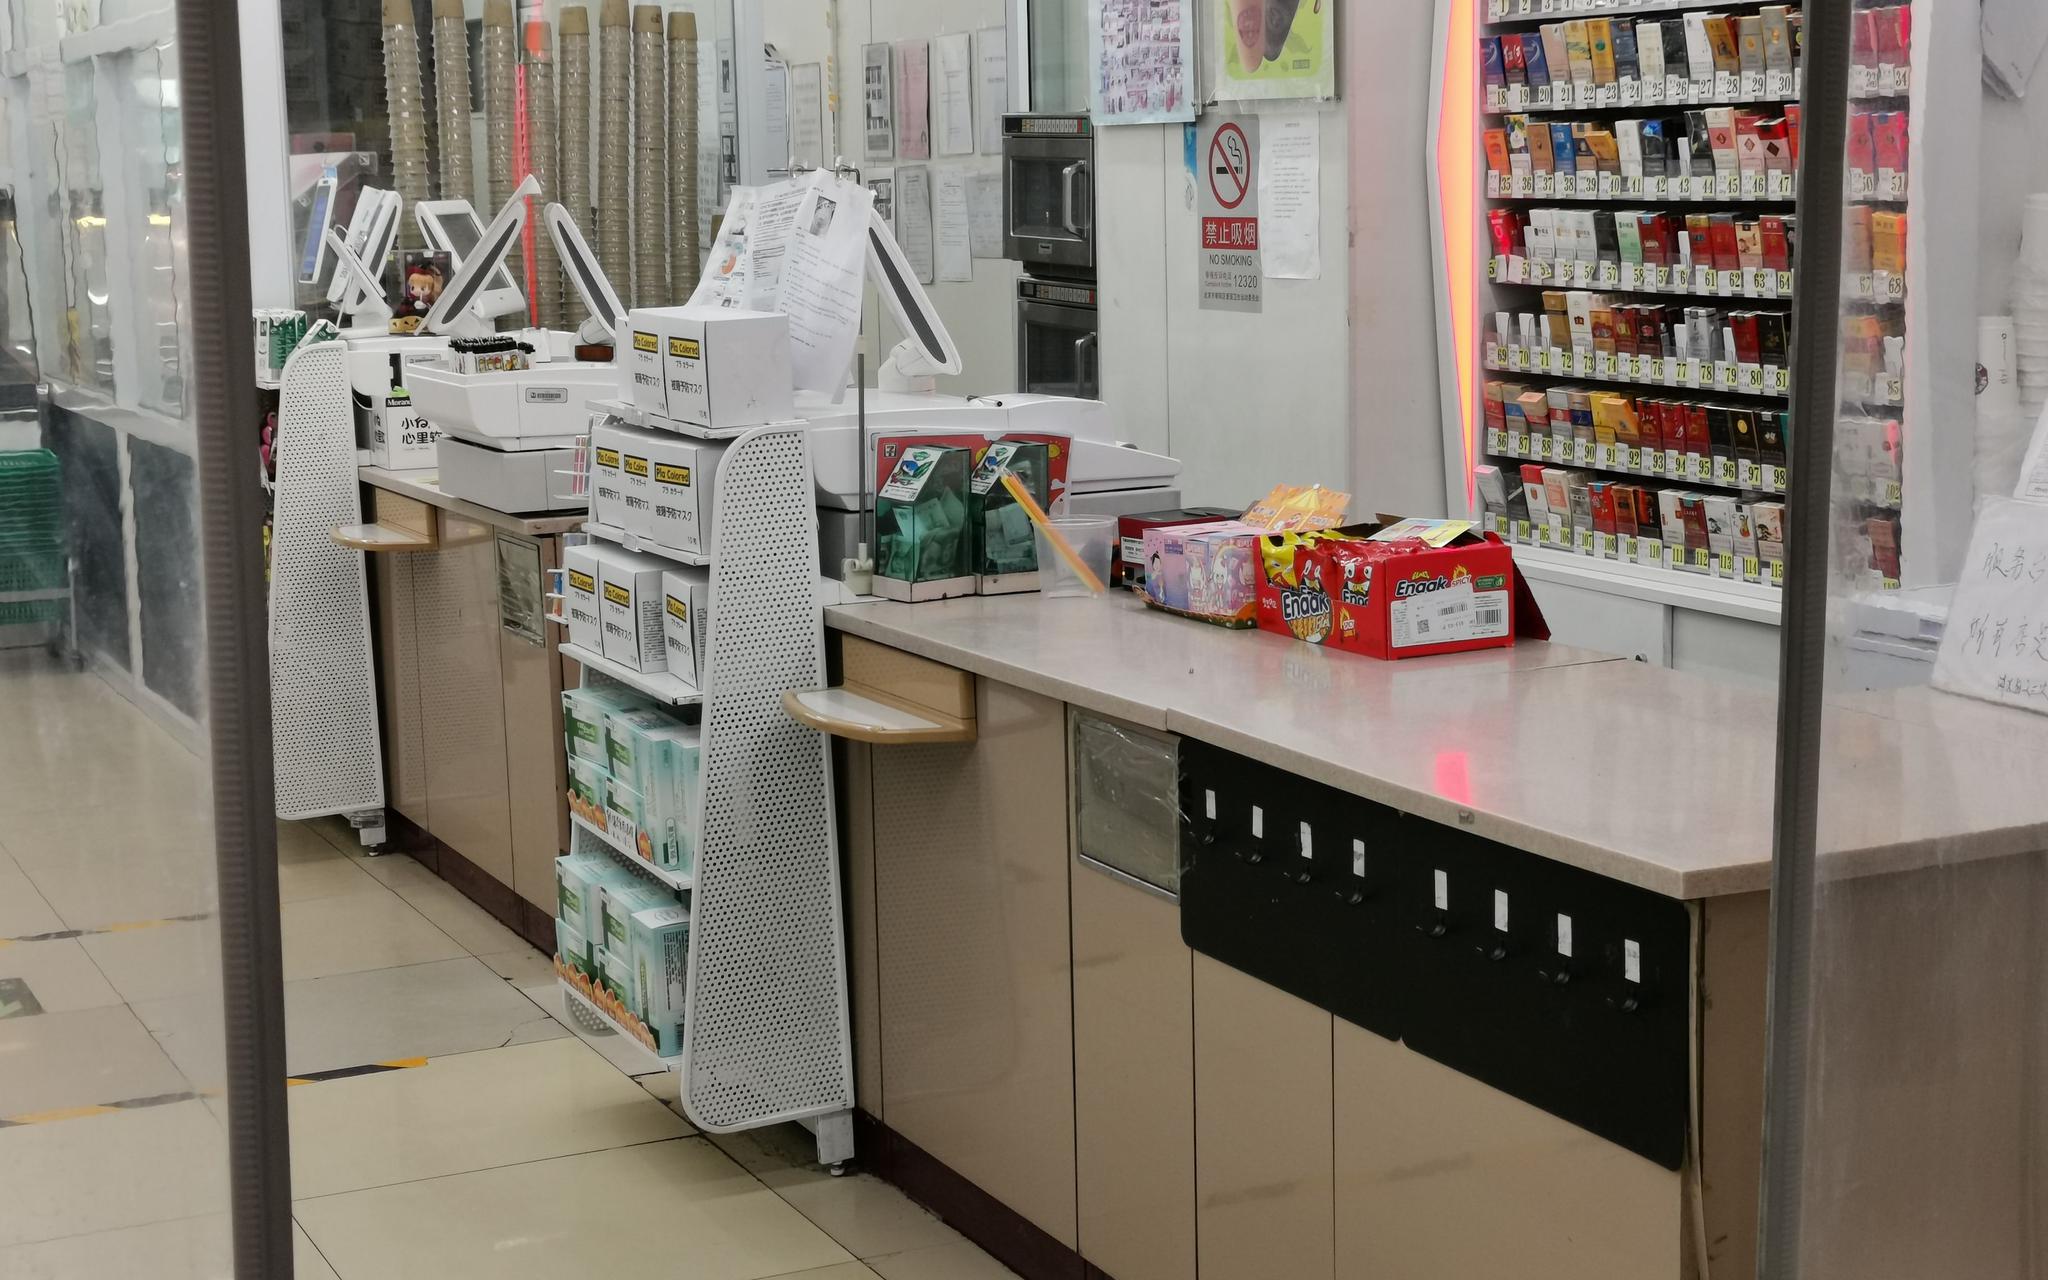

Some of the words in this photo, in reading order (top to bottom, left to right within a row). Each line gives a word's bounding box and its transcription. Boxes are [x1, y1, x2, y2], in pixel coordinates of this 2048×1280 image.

[1629, 83, 1640, 98] 24
[1652, 81, 1663, 97] 25
[1676, 80, 1687, 96] 26
[1700, 80, 1712, 95] 27
[1727, 78, 1738, 94] 28
[1752, 76, 1763, 93] 29
[1779, 76, 1791, 92] 30
[1497, 89, 1507, 105] 18
[1520, 88, 1529, 103] 19
[1539, 87, 1550, 102] 20
[1561, 87, 1570, 102] 21
[1584, 86, 1594, 101] 22
[1606, 85, 1616, 100] 23
[1501, 177, 1511, 192] 35
[1522, 177, 1532, 192] 36
[1543, 177, 1553, 192] 37
[1564, 177, 1574, 192] 38
[1586, 177, 1596, 192] 39
[1206, 221, 1256, 246] 禁止吸烟
[1209, 254, 1219, 265] NO
[1221, 254, 1252, 266] SMOKING
[1233, 274, 1258, 288] 12320
[1705, 272, 1715, 287] 61
[1730, 272, 1740, 287] 62
[1754, 272, 1765, 288] 63
[1779, 273, 1790, 289] 64
[1889, 278, 1901, 294] 68
[1497, 348, 1507, 363] 69
[1519, 349, 1529, 365] 70
[1540, 353, 1549, 367] 71
[1562, 354, 1572, 369] 72
[1584, 355, 1594, 370] 73
[1607, 357, 1617, 372] 74
[1630, 359, 1640, 374] 75
[1653, 361, 1663, 376] 76
[1677, 363, 1687, 378] 77
[1701, 365, 1712, 380] 78
[1725, 368, 1737, 383] 79
[1750, 370, 1762, 385] 80
[1776, 372, 1786, 387] 81
[1497, 433, 1507, 448] 86
[1518, 436, 1528, 451] 87
[1541, 439, 1551, 454] 88
[1562, 442, 1573, 457] 89
[1584, 444, 1595, 460] 90
[1607, 448, 1616, 463] 91
[1629, 450, 1640, 465] 92
[1653, 454, 1663, 470] 93
[1676, 457, 1686, 472] 94
[1699, 460, 1710, 475] 95
[1723, 463, 1734, 478] 96
[1748, 466, 1759, 481] 97
[1774, 469, 1785, 484] 98
[1497, 519, 1507, 534] 103
[1519, 523, 1529, 537] 104
[1539, 527, 1550, 542] 105
[1560, 530, 1570, 545] 106
[1582, 533, 1592, 548] 107
[1604, 537, 1615, 552] 108
[1626, 541, 1637, 556] 109
[1649, 544, 1660, 559] 110
[1673, 548, 1683, 563] 111
[1696, 552, 1707, 566] 112
[1720, 555, 1731, 570] 113
[1745, 559, 1757, 575] 114
[1771, 563, 1783, 578] 115
[1395, 575, 1447, 597] Enaak
[1282, 591, 1331, 621] Enaak
